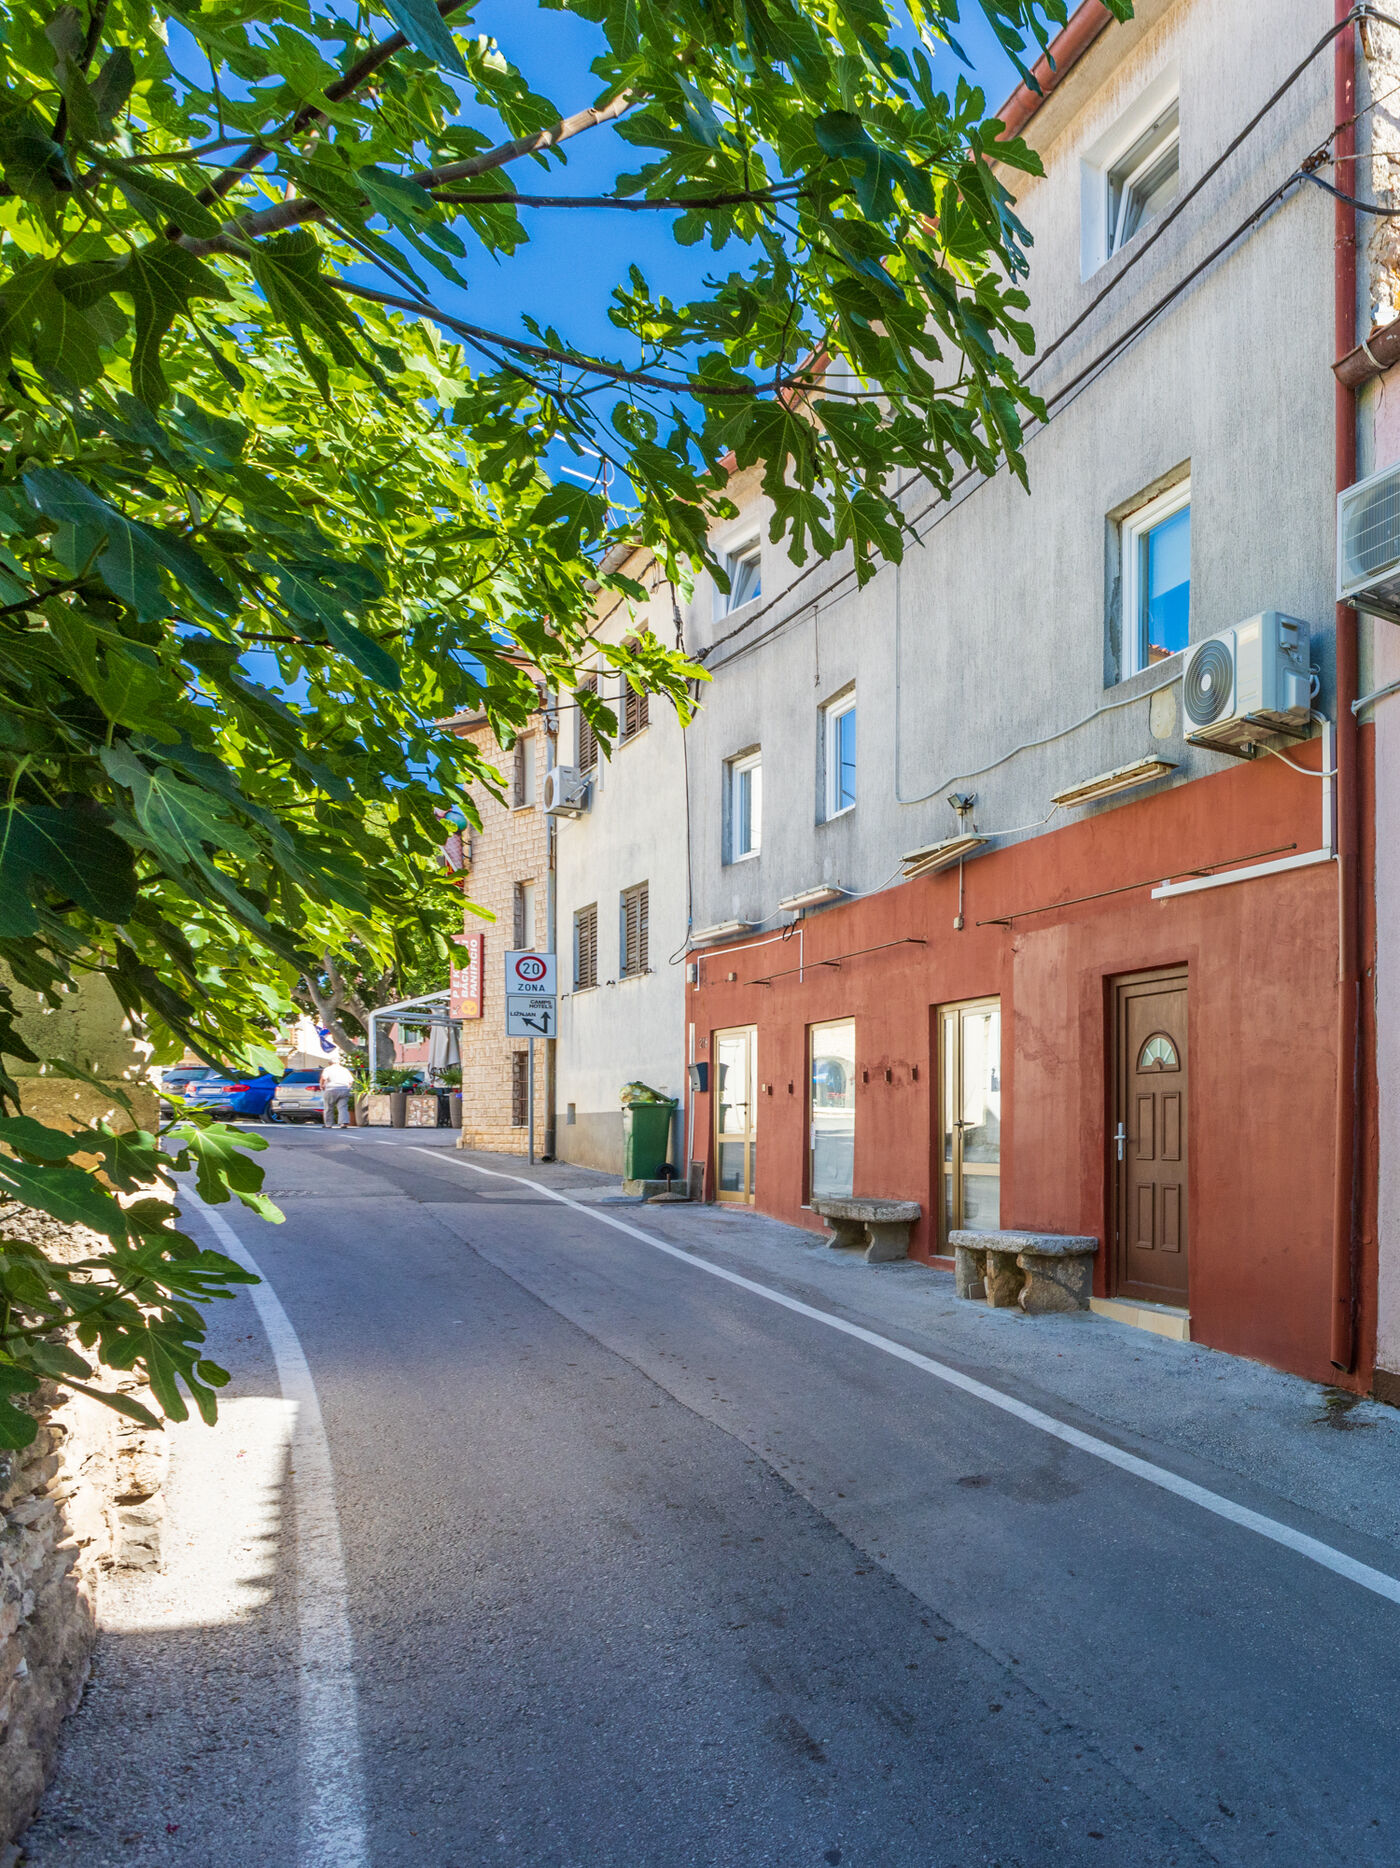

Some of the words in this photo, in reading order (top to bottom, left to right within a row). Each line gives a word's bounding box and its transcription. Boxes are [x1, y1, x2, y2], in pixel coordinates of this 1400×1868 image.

[470, 939, 478, 998] PANIFICIO
[522, 962, 540, 975] 20
[518, 983, 546, 992] ZONA
